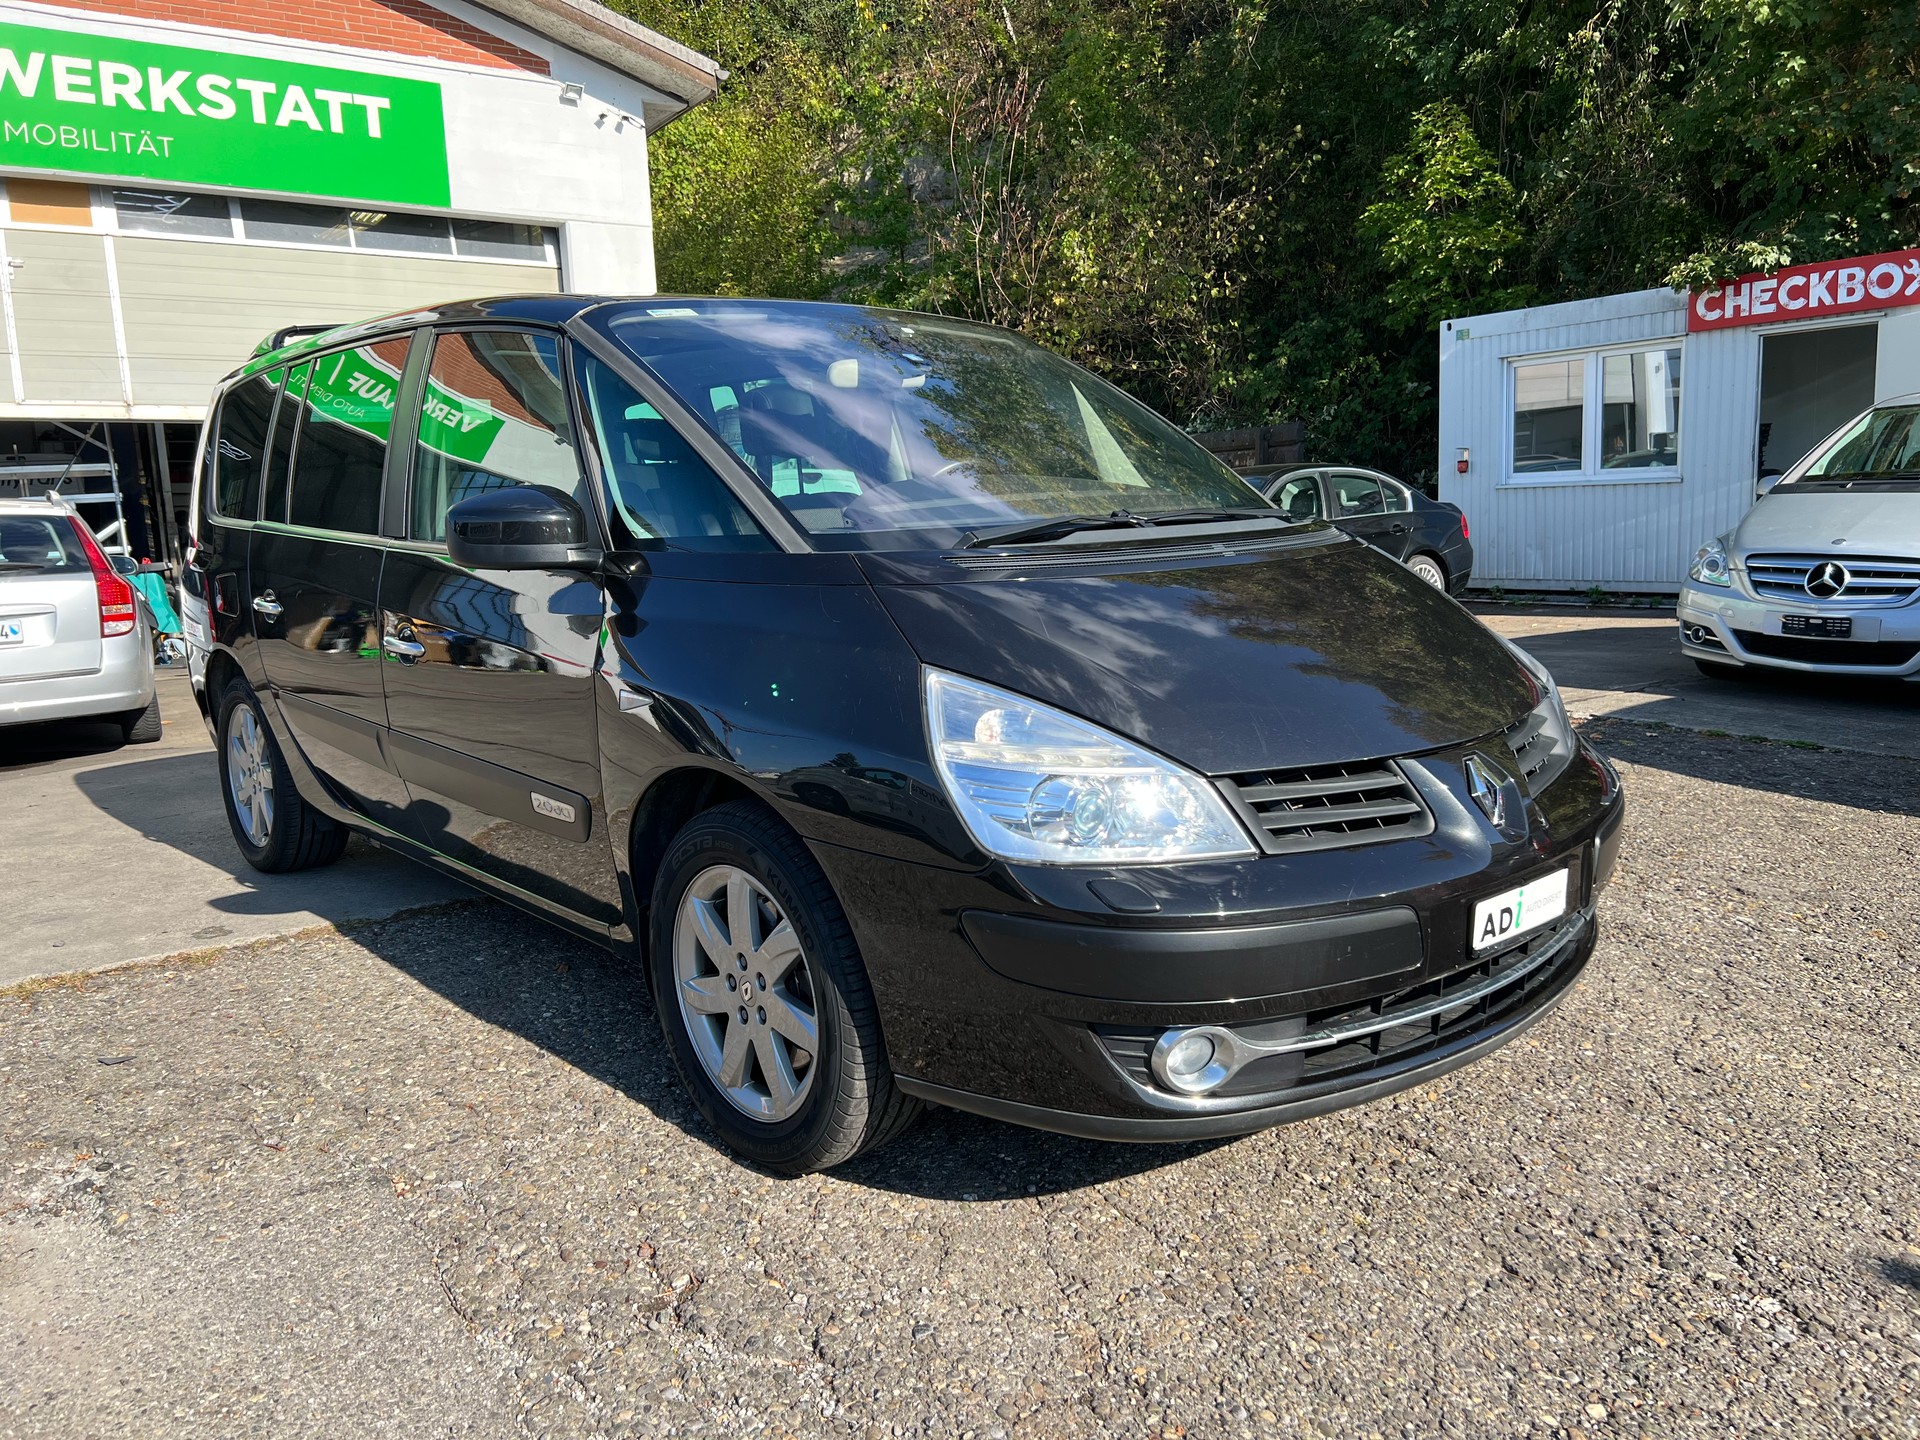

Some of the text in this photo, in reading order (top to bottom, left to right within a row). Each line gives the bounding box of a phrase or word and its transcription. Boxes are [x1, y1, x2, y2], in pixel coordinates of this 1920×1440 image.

[0, 47, 391, 139] WERKSTATT
[4, 120, 174, 158] MOBILITÄT
[767, 867, 815, 953] KUMHO
